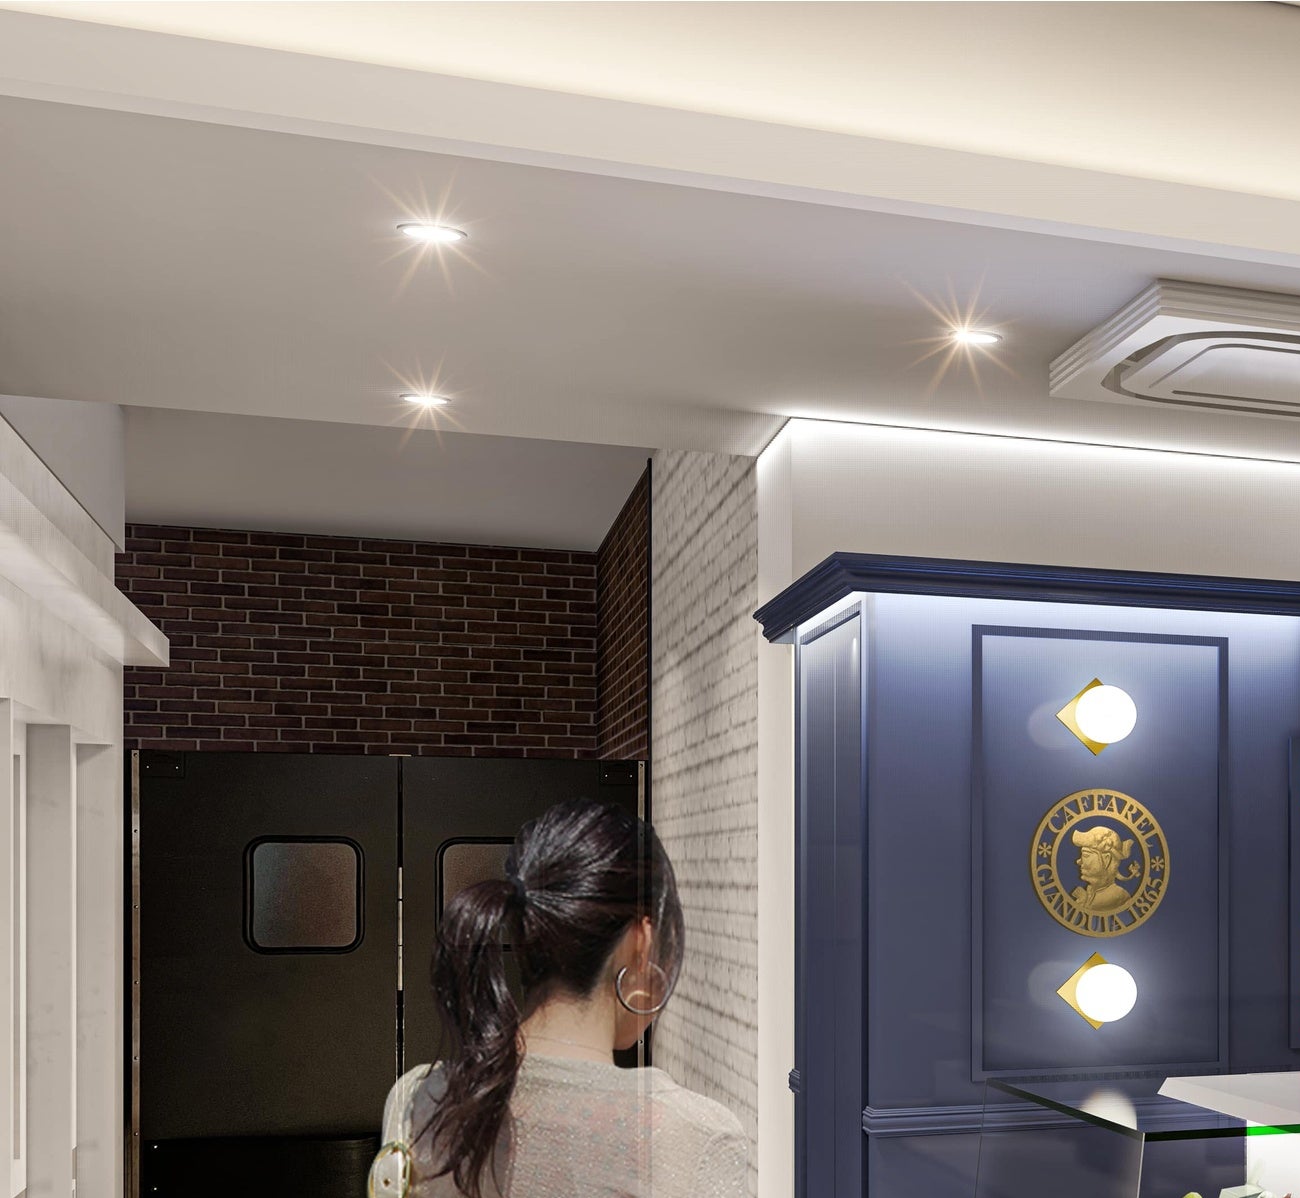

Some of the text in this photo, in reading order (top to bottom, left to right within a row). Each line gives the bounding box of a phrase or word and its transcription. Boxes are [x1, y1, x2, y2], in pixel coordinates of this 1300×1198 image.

[1047, 795, 1159, 848] CAFFAREL
[1036, 863, 1163, 933] GIANDUIA 1865
